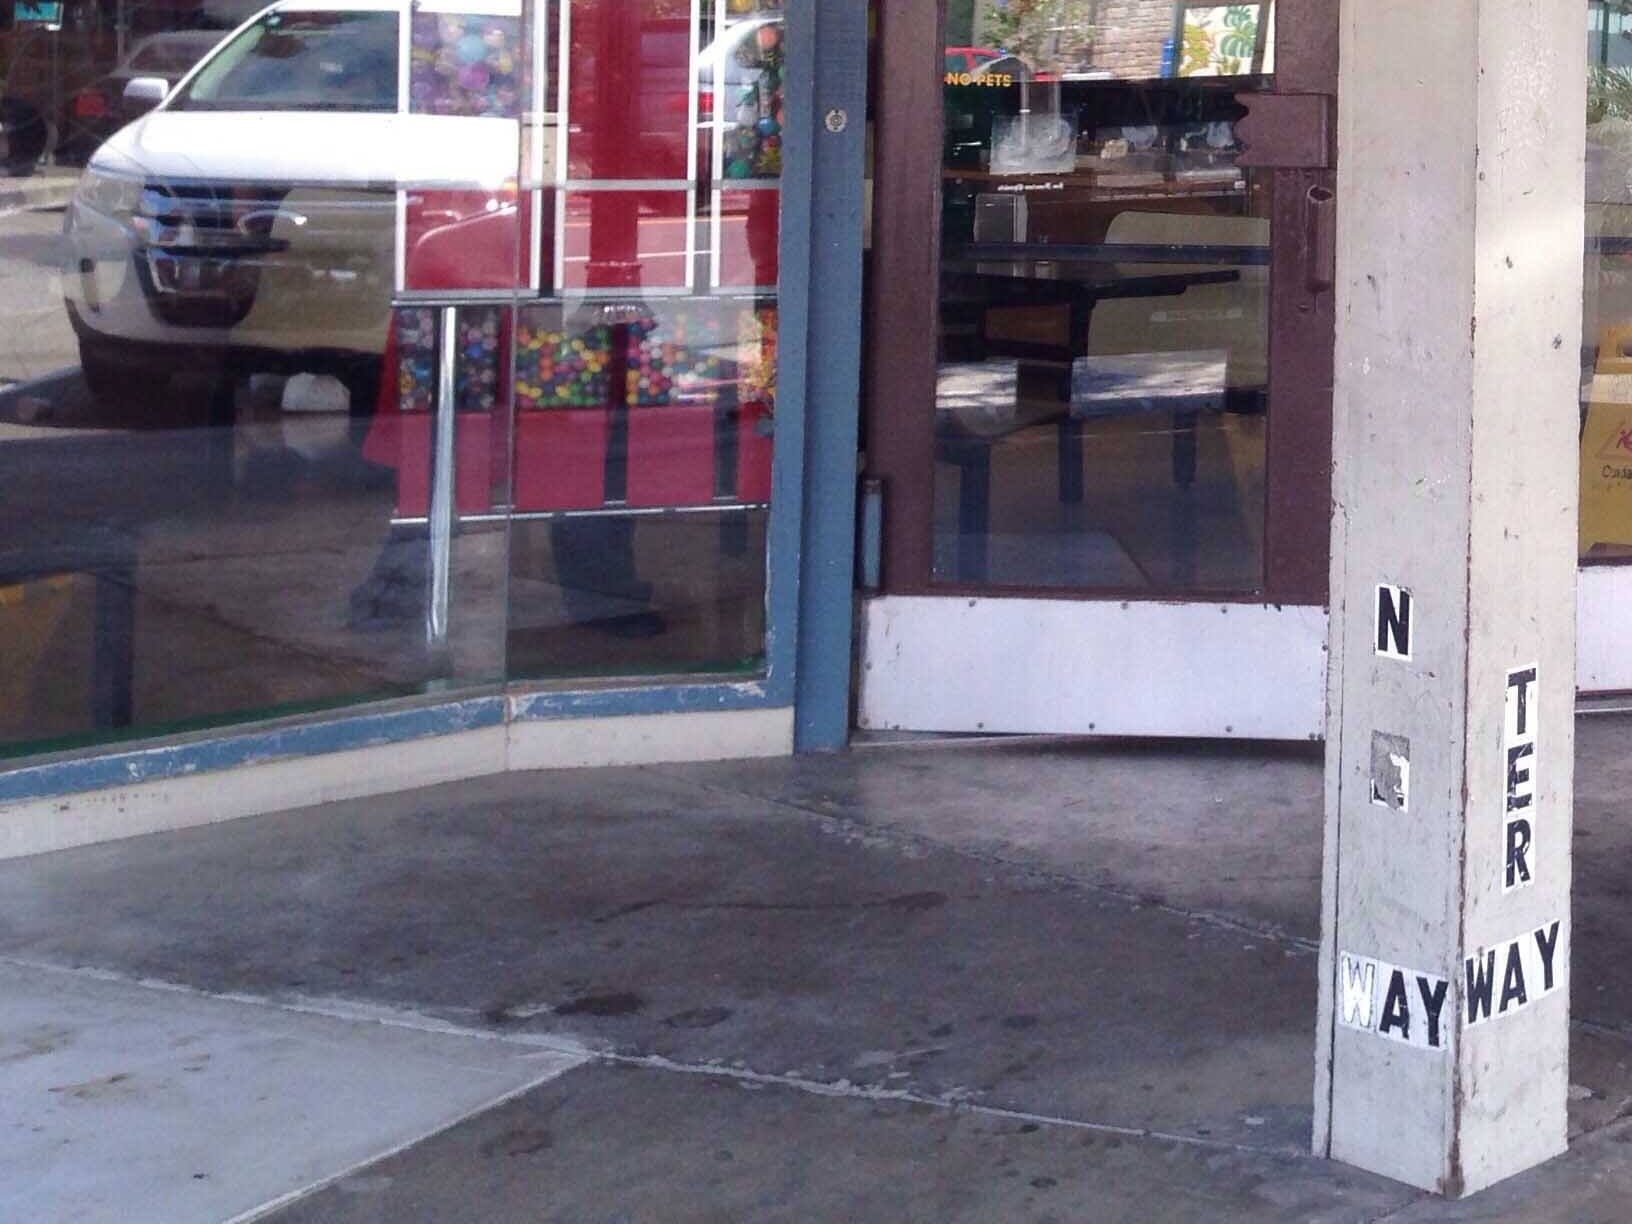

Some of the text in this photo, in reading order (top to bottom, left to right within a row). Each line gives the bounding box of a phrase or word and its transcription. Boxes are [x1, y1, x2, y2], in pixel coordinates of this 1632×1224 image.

[946, 72, 1012, 87] NO PETS
[1377, 586, 1411, 656] N
[1342, 954, 1449, 1048] WAY
[1465, 921, 1560, 1024] WAY
